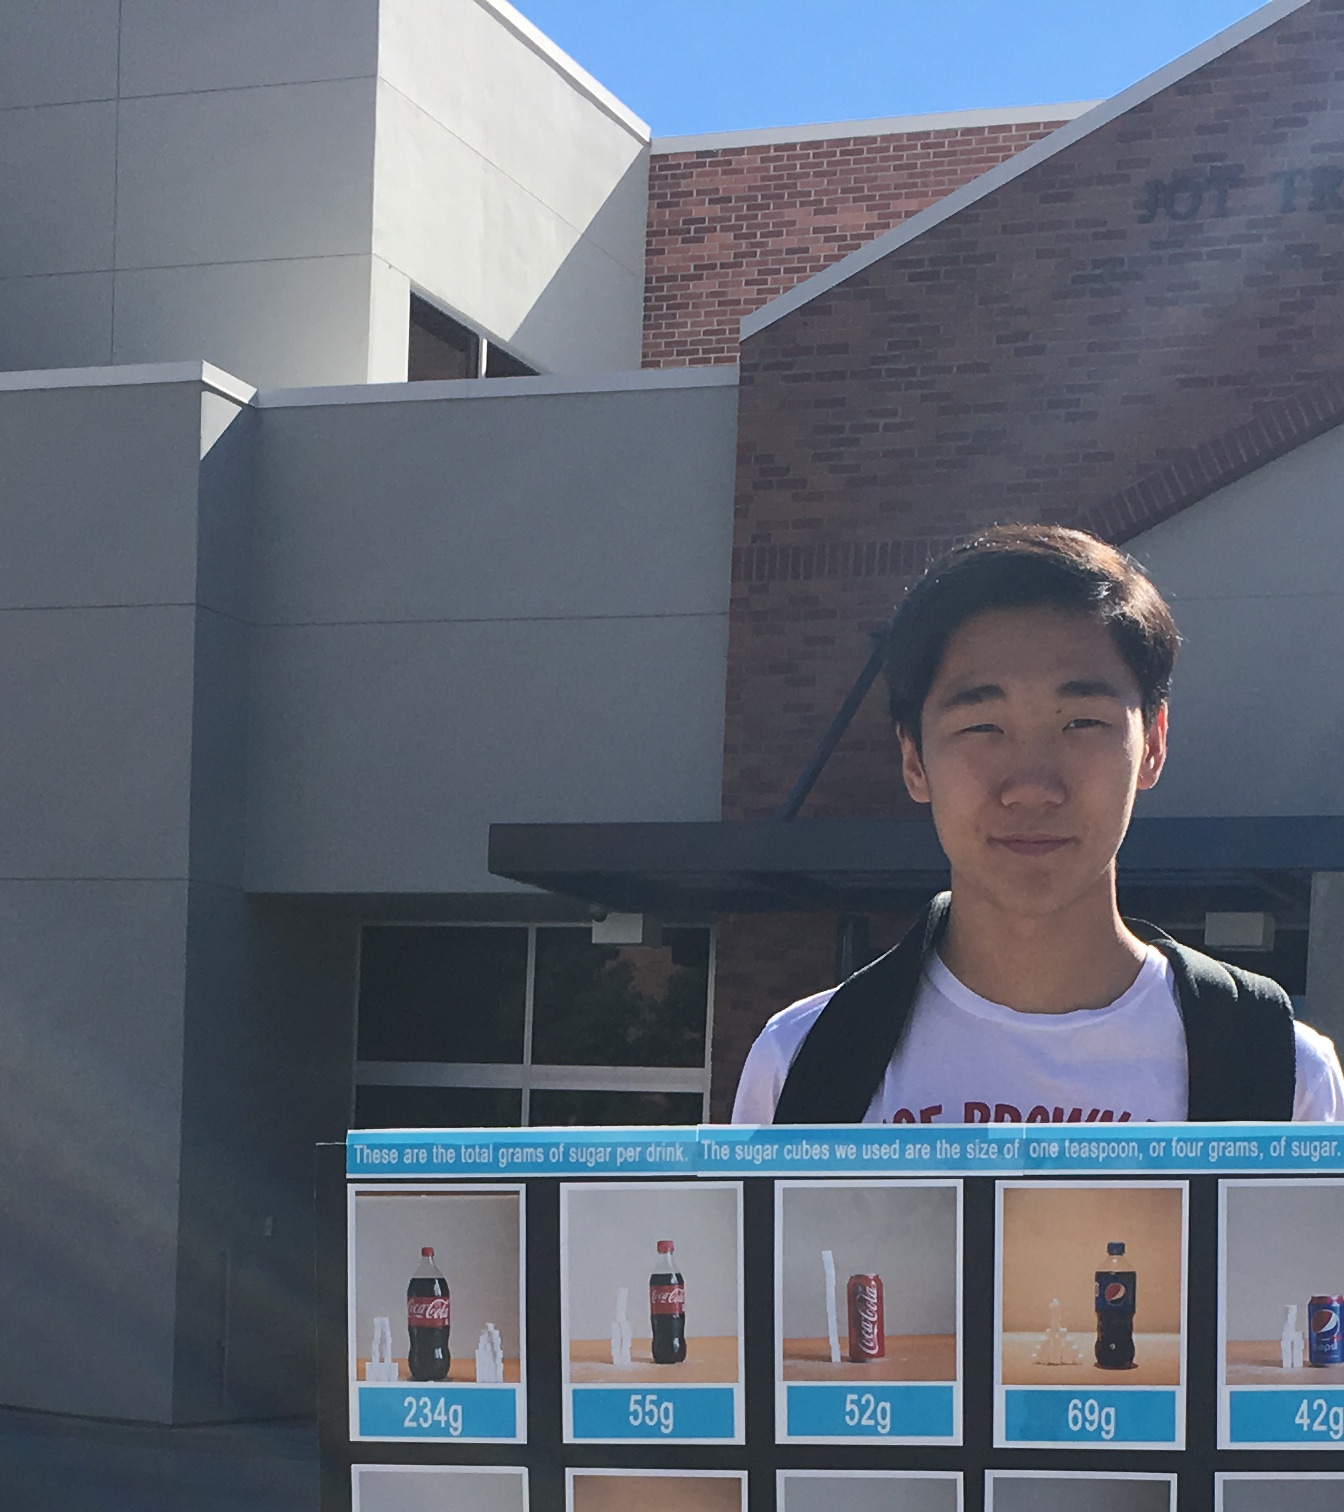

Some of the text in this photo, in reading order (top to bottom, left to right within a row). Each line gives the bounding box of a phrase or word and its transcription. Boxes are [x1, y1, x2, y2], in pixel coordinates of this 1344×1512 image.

[354, 1137, 1342, 1167] These are the total grams of sugar per drink. The sugar cubes we used are the size of one teaspoon, or four grams, of sugar.
[403, 1396, 463, 1436] 234g
[629, 1395, 674, 1434] 55g
[845, 1393, 891, 1434] 52g
[1068, 1399, 1116, 1439] 69g
[1294, 1398, 1344, 1440] 42g
